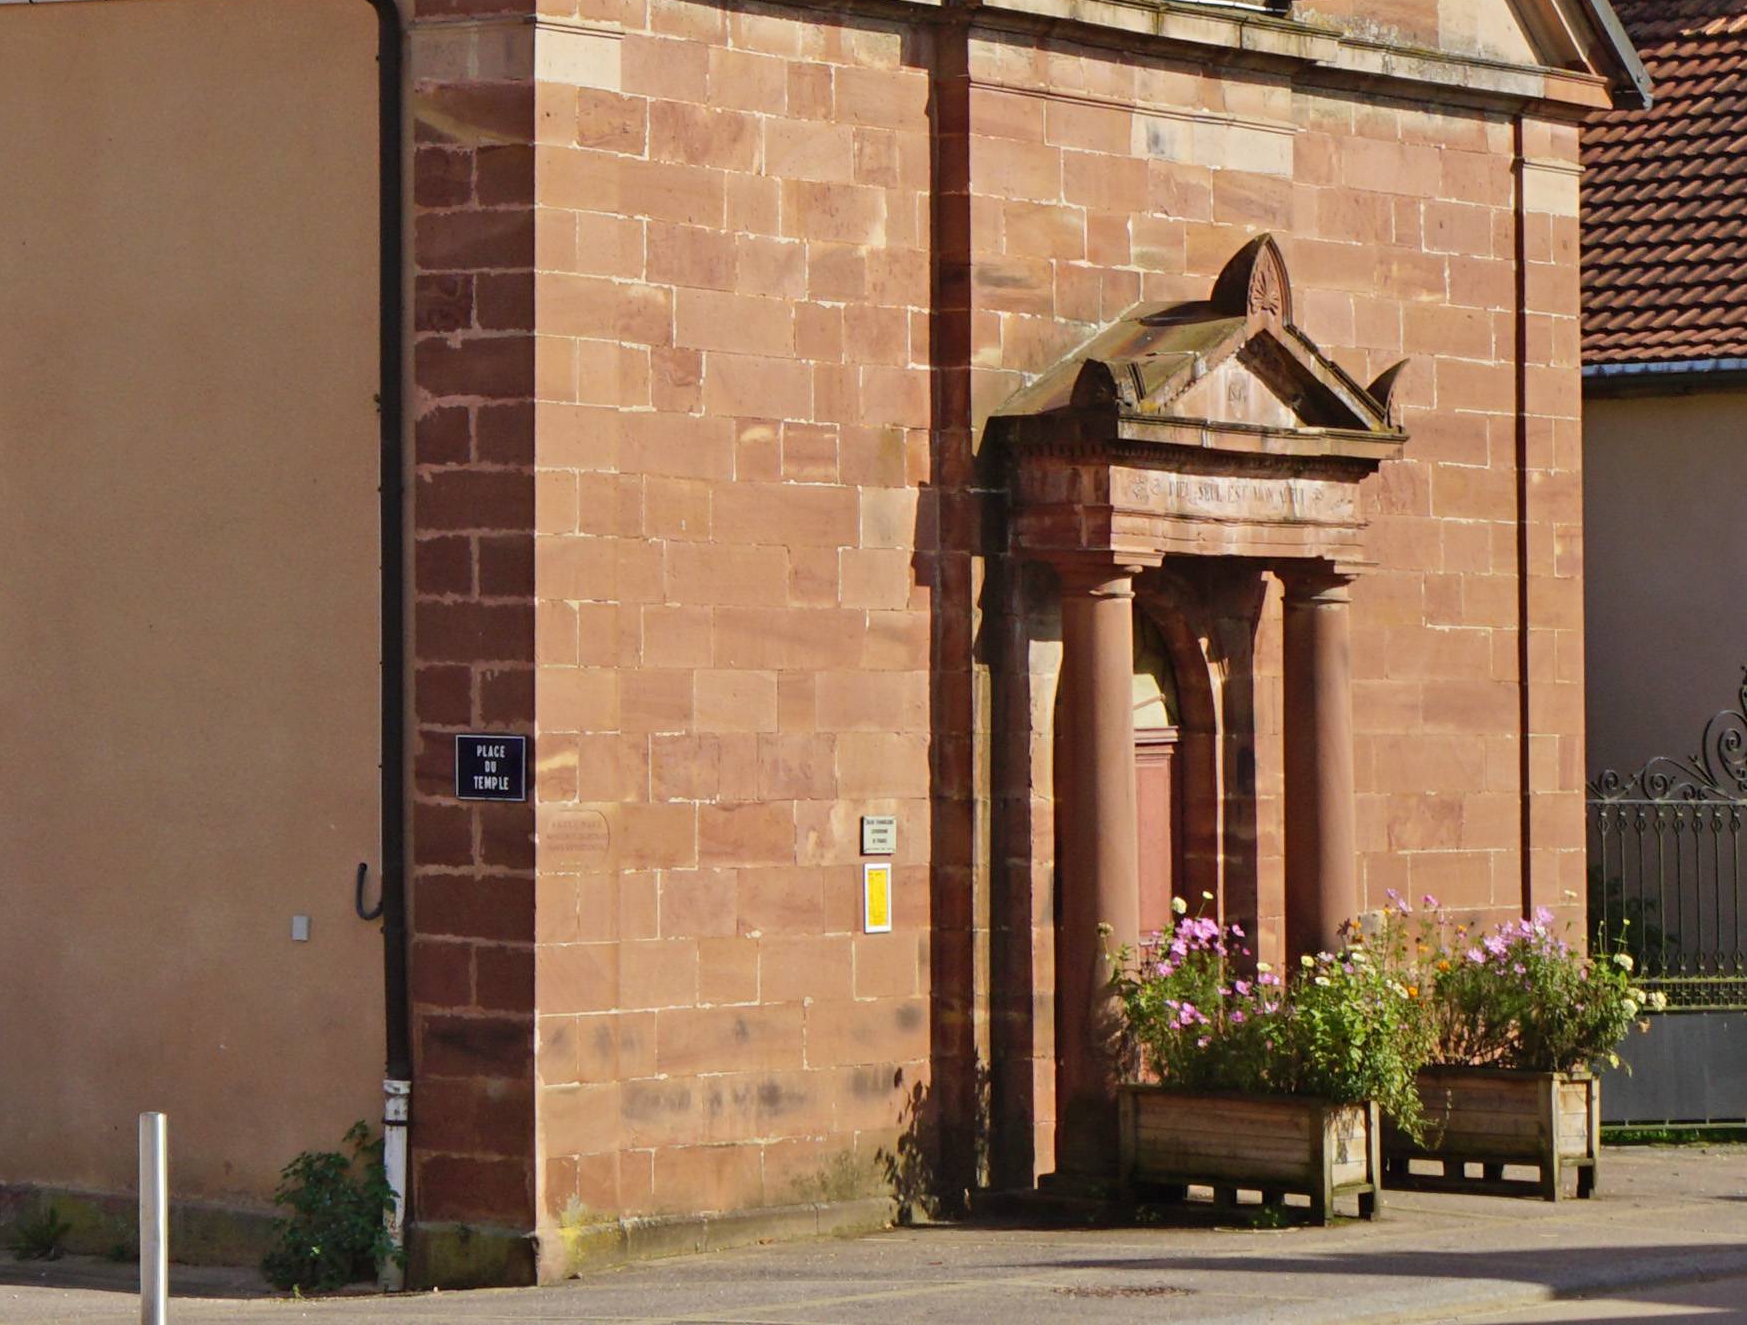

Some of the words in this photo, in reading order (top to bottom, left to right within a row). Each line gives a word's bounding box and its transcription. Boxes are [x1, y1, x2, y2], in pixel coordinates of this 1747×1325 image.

[476, 744, 505, 758] PLACE
[484, 760, 497, 773] DU
[473, 775, 509, 791] TEMPLE
